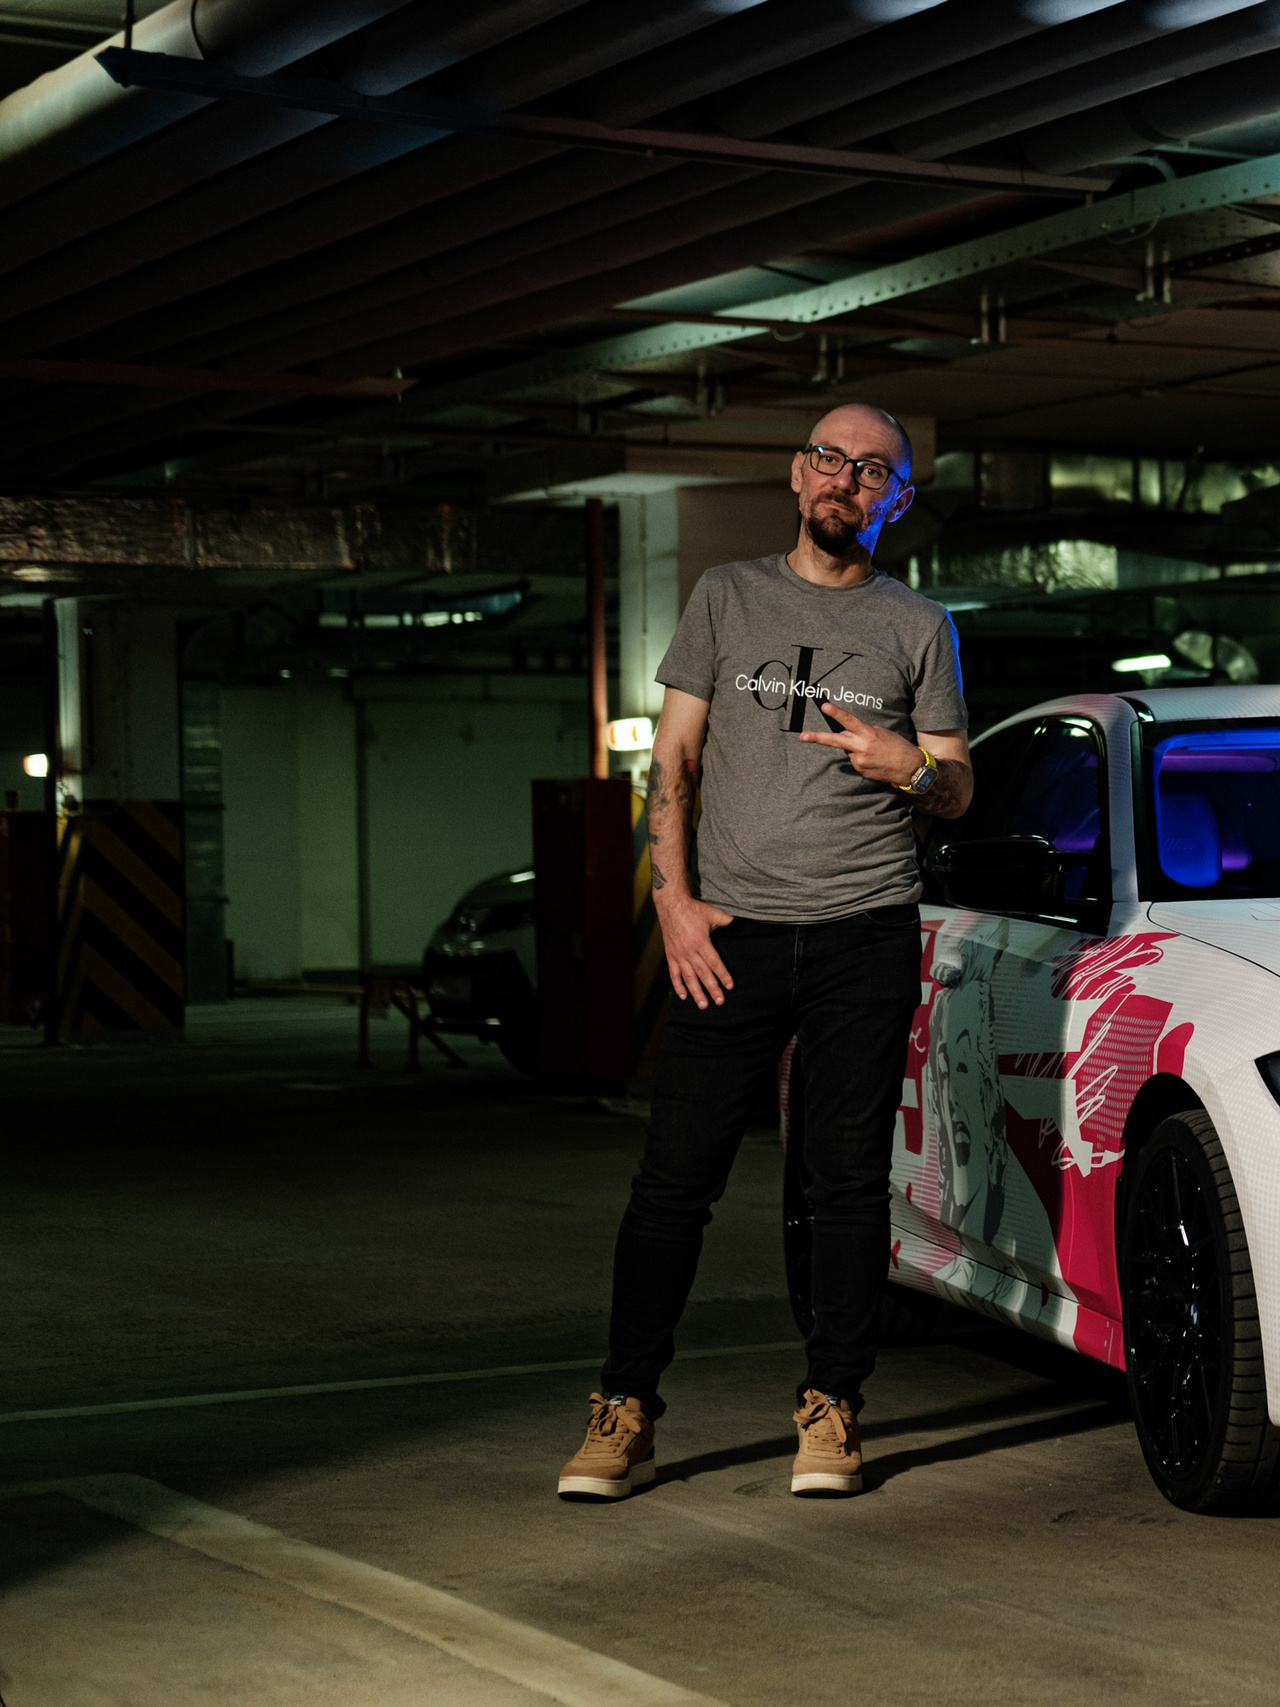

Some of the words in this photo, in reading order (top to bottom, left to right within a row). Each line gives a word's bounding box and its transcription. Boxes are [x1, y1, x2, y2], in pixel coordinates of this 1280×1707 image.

[735, 674, 786, 694] Calvin
[789, 679, 831, 699] Klein
[833, 686, 884, 710] Jeans
